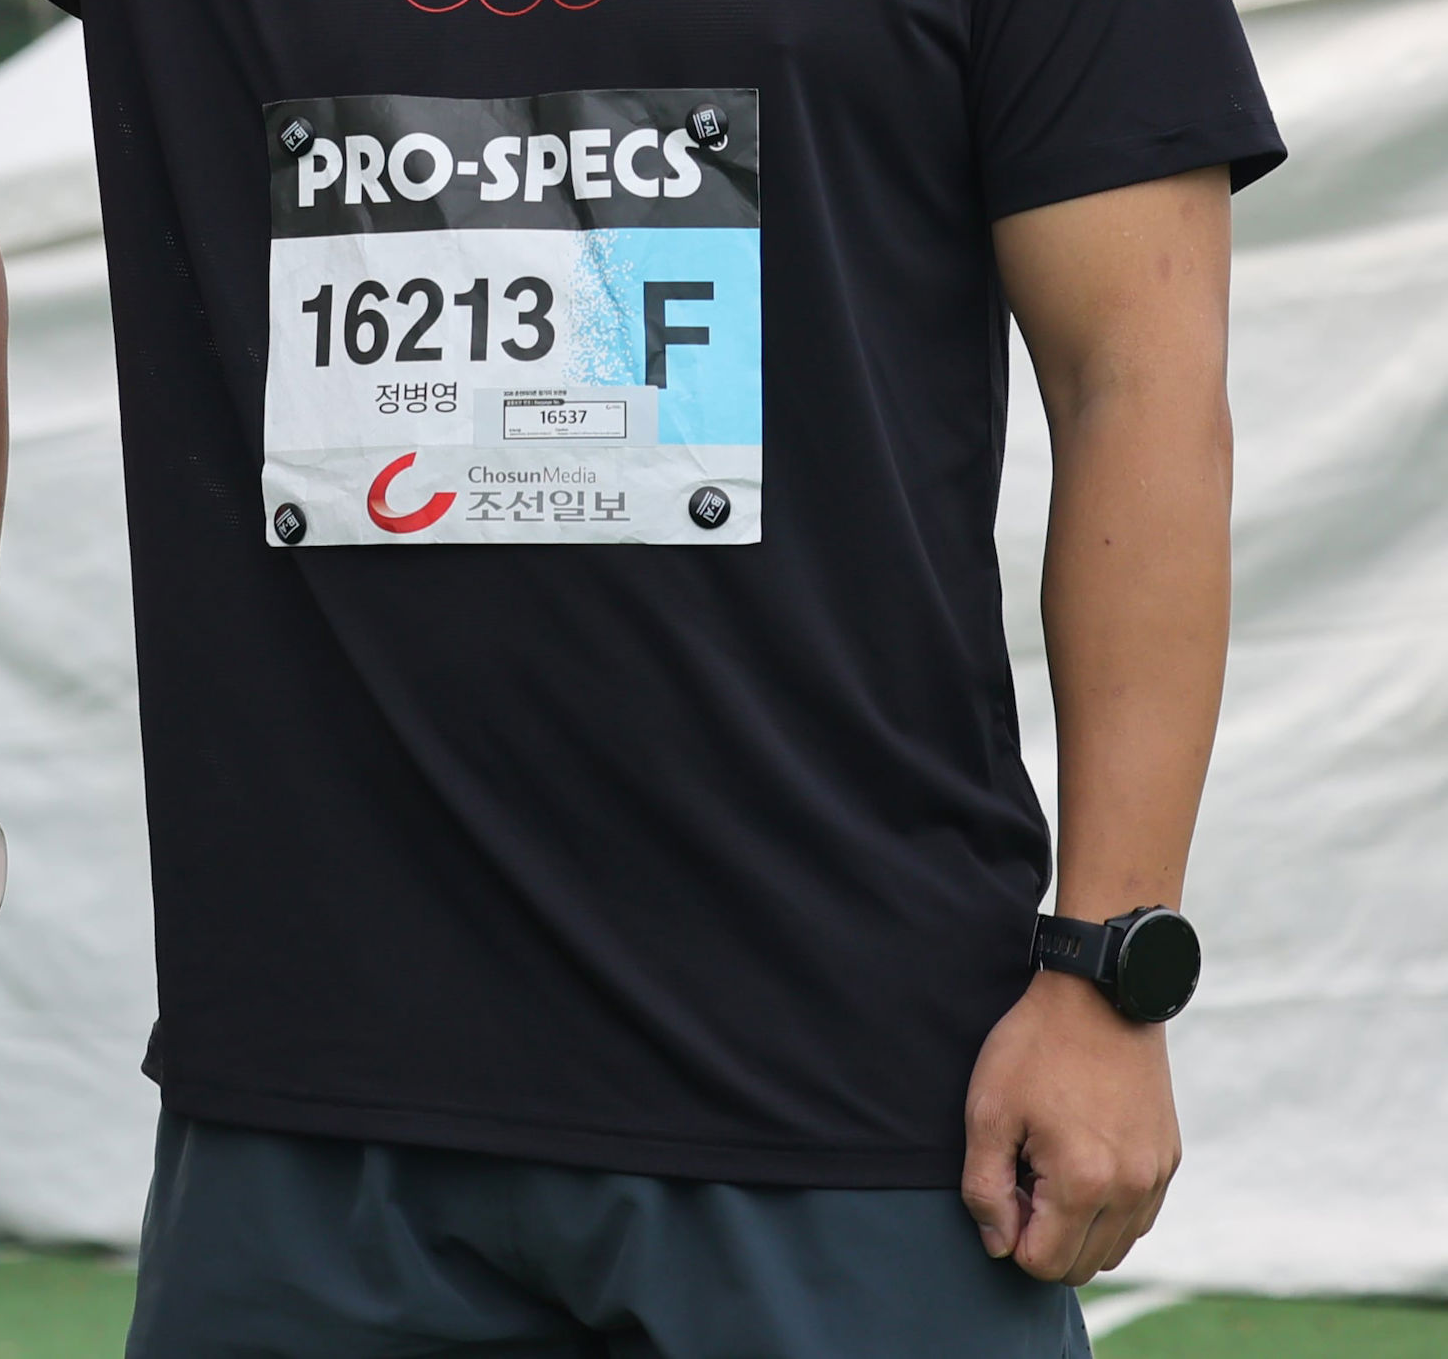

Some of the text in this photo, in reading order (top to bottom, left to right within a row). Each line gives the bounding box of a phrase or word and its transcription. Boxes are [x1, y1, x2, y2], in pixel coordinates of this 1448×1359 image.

[298, 128, 703, 208] PRO-SPECS
[301, 276, 555, 368] 16213
[643, 280, 715, 390] F
[374, 381, 459, 415] 정병영
[539, 409, 588, 426] 16537
[467, 465, 597, 485] ChosunMedia
[465, 490, 631, 523] 조선일보
